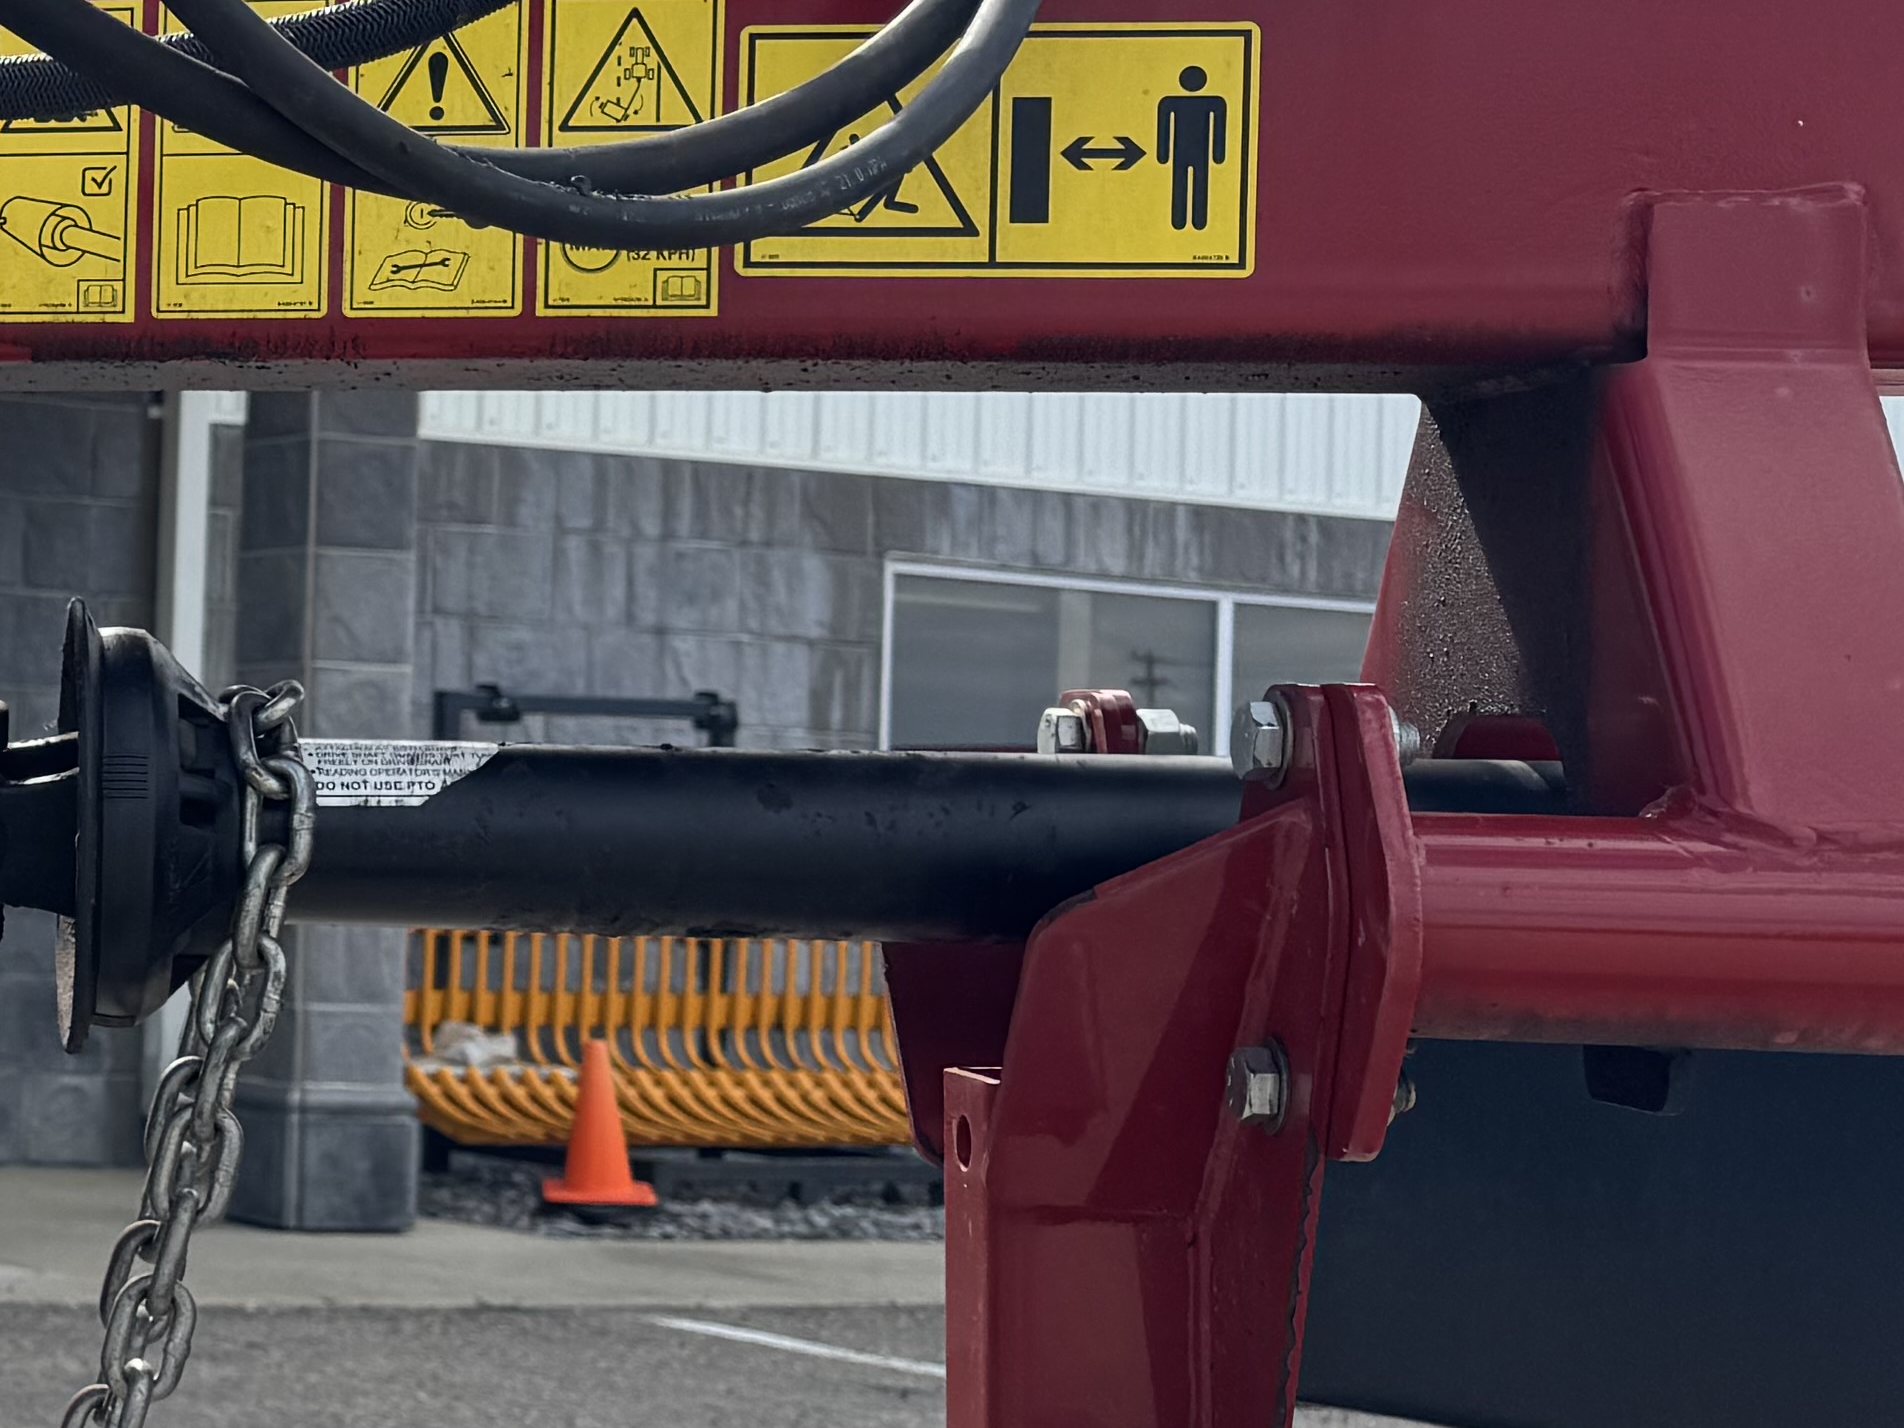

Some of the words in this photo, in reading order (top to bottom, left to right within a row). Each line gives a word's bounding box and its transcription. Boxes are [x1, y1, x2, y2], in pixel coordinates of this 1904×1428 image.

[341, 780, 368, 791] NOT
[373, 780, 404, 791] USE
[406, 780, 435, 791] PTO
